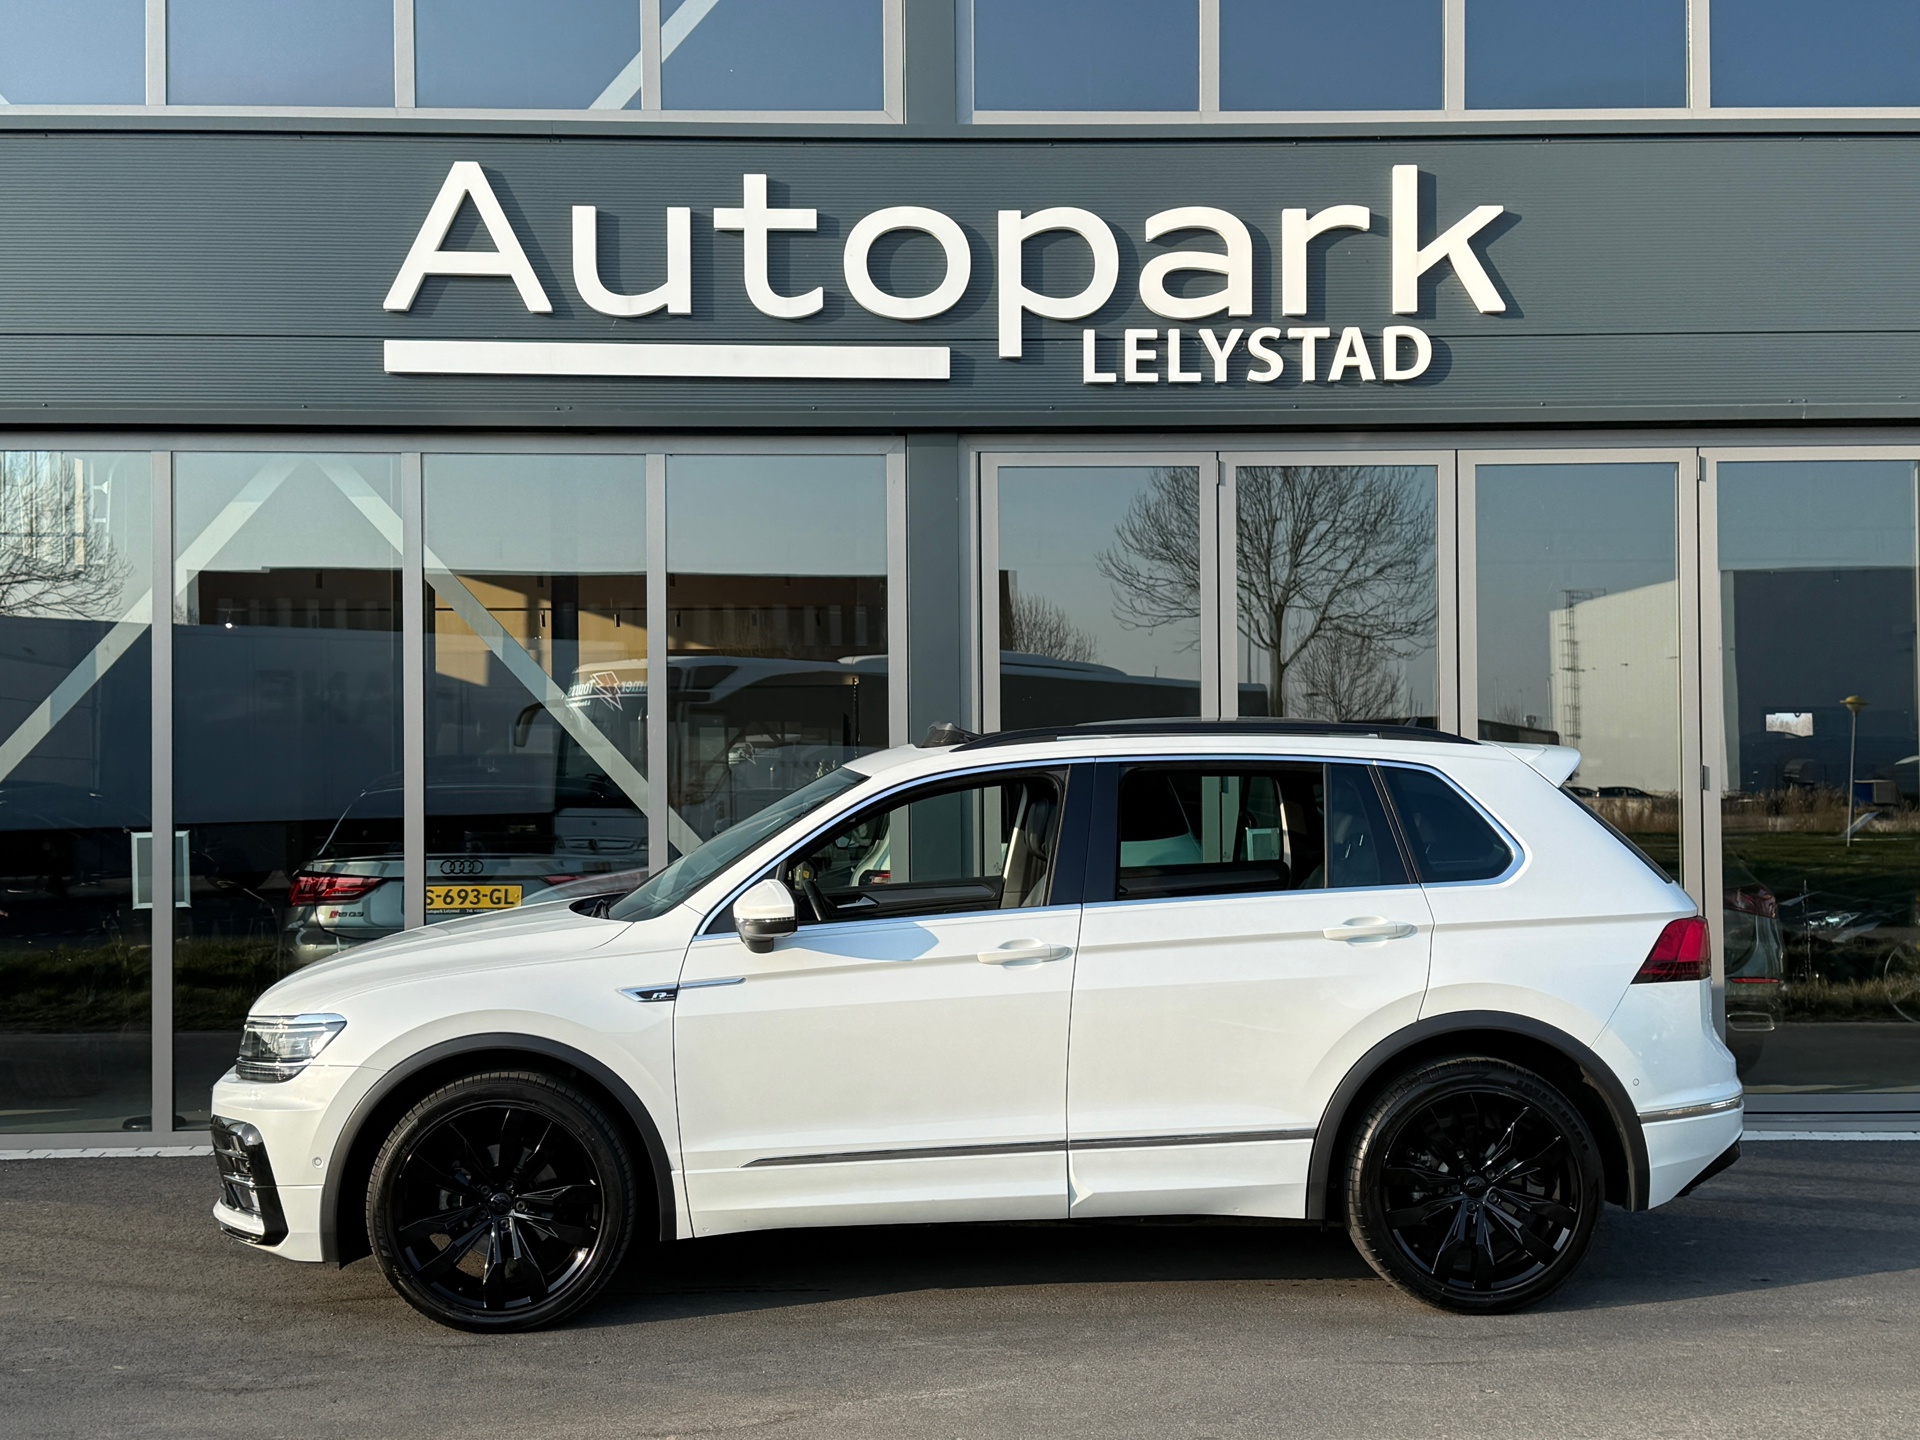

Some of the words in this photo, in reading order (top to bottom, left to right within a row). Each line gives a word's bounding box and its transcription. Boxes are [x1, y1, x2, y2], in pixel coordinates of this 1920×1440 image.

[383, 161, 1505, 358] Autopark
[1083, 326, 1432, 385] LELYSTAD
[426, 888, 515, 906] S-693-GL
